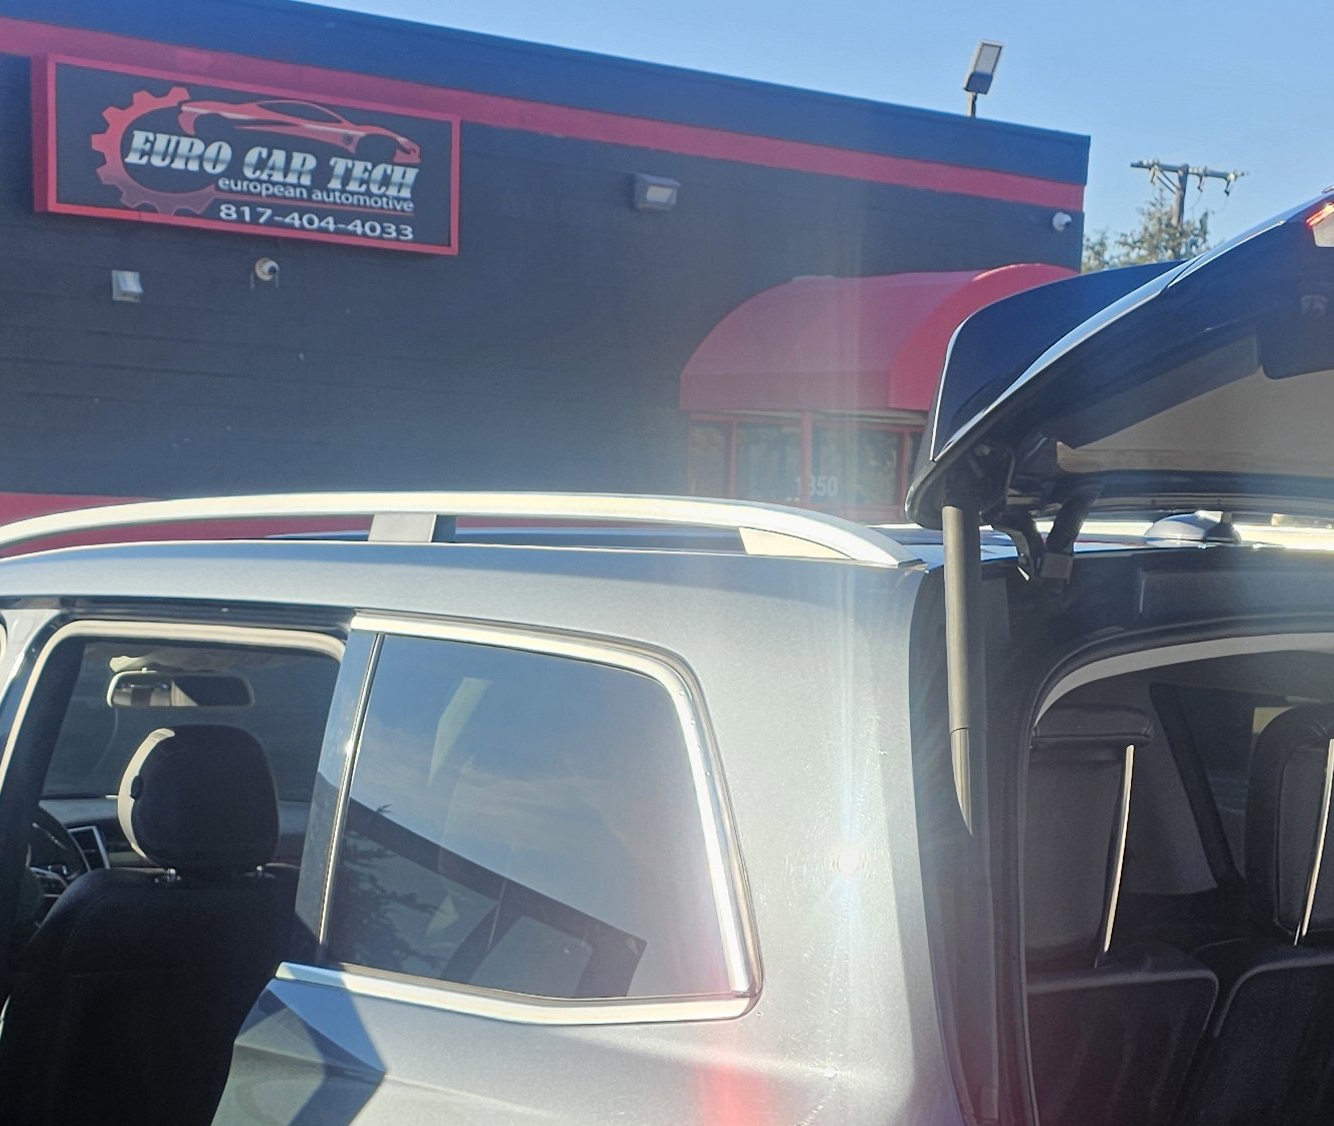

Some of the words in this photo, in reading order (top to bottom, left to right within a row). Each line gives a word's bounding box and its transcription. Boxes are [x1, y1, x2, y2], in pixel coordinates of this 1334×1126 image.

[125, 130, 232, 175] EURO
[243, 145, 316, 187] CAR
[328, 157, 419, 198] TECH
[218, 175, 308, 201] european
[311, 185, 415, 213] automotive
[219, 203, 414, 240] 817-404-4033
